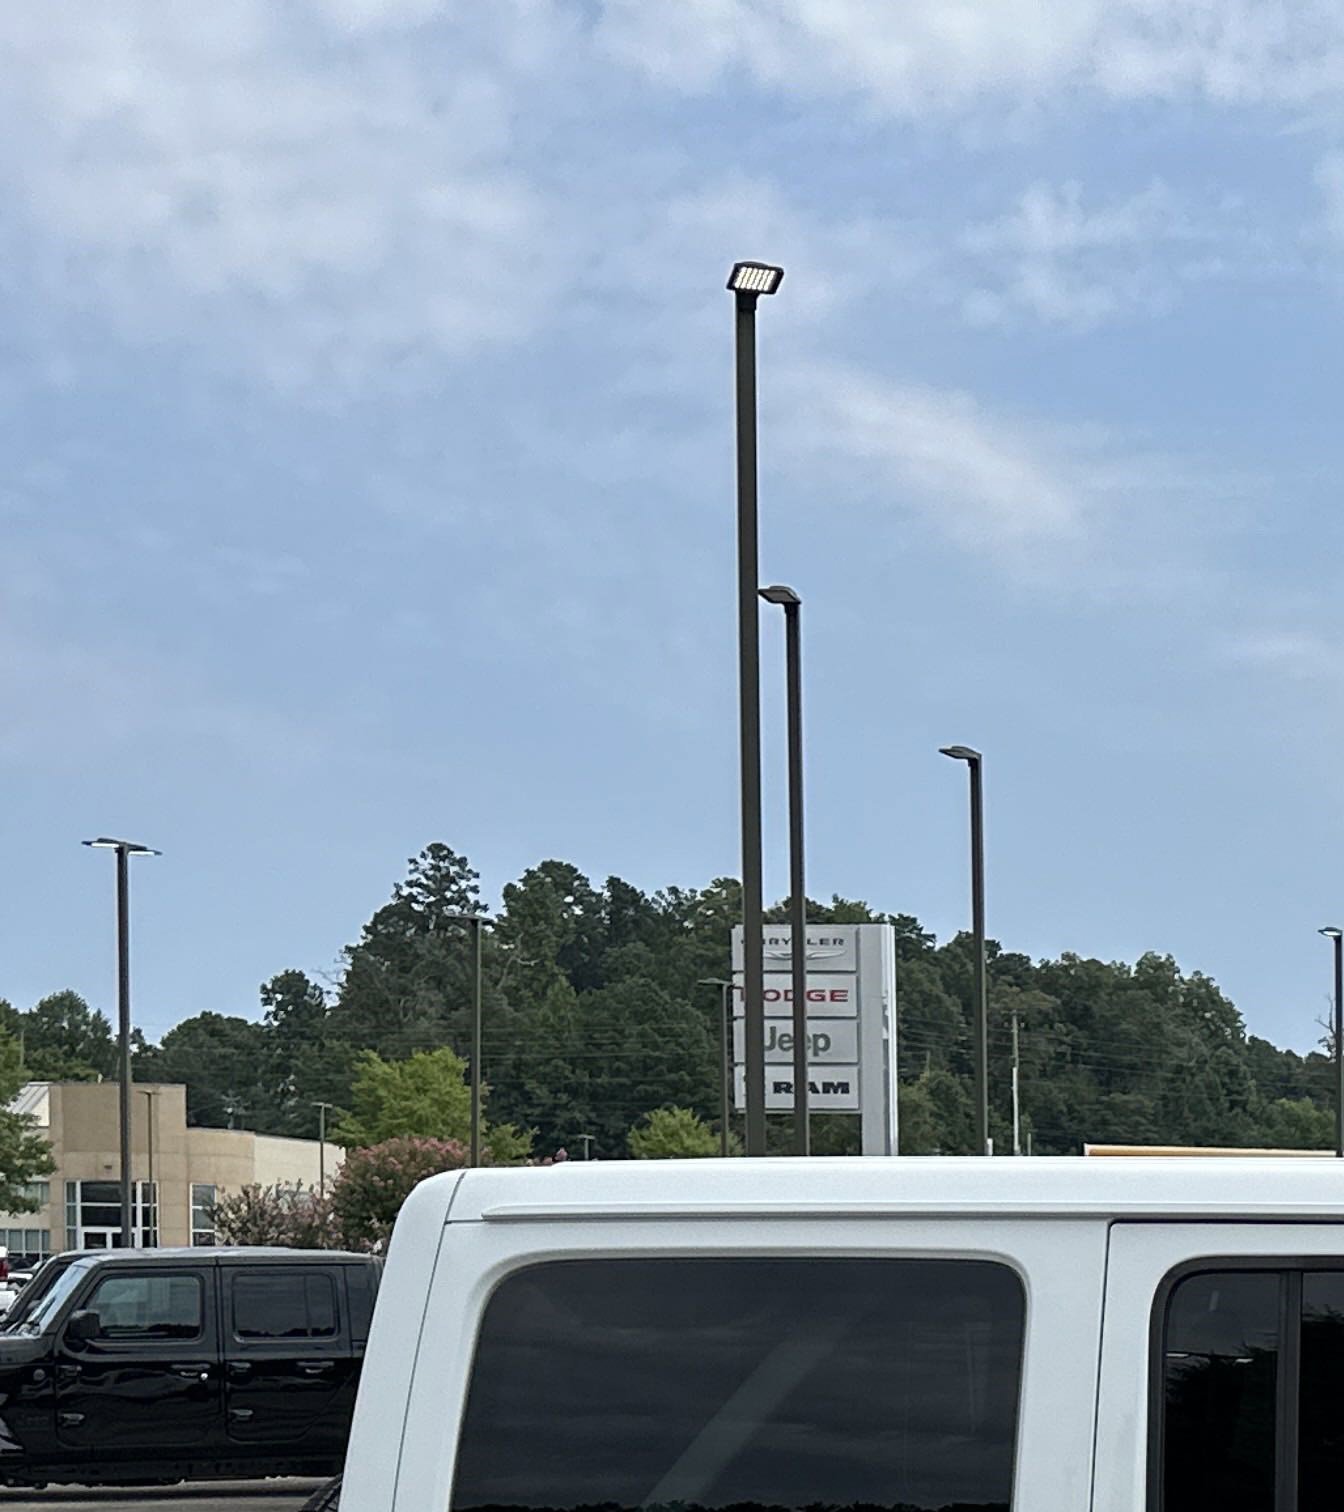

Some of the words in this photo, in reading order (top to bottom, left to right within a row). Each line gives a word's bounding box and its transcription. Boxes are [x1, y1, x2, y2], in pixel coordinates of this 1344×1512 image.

[741, 938, 844, 946] RYLER
[741, 990, 848, 1002] OGE
[773, 1082, 849, 1093] RAM
